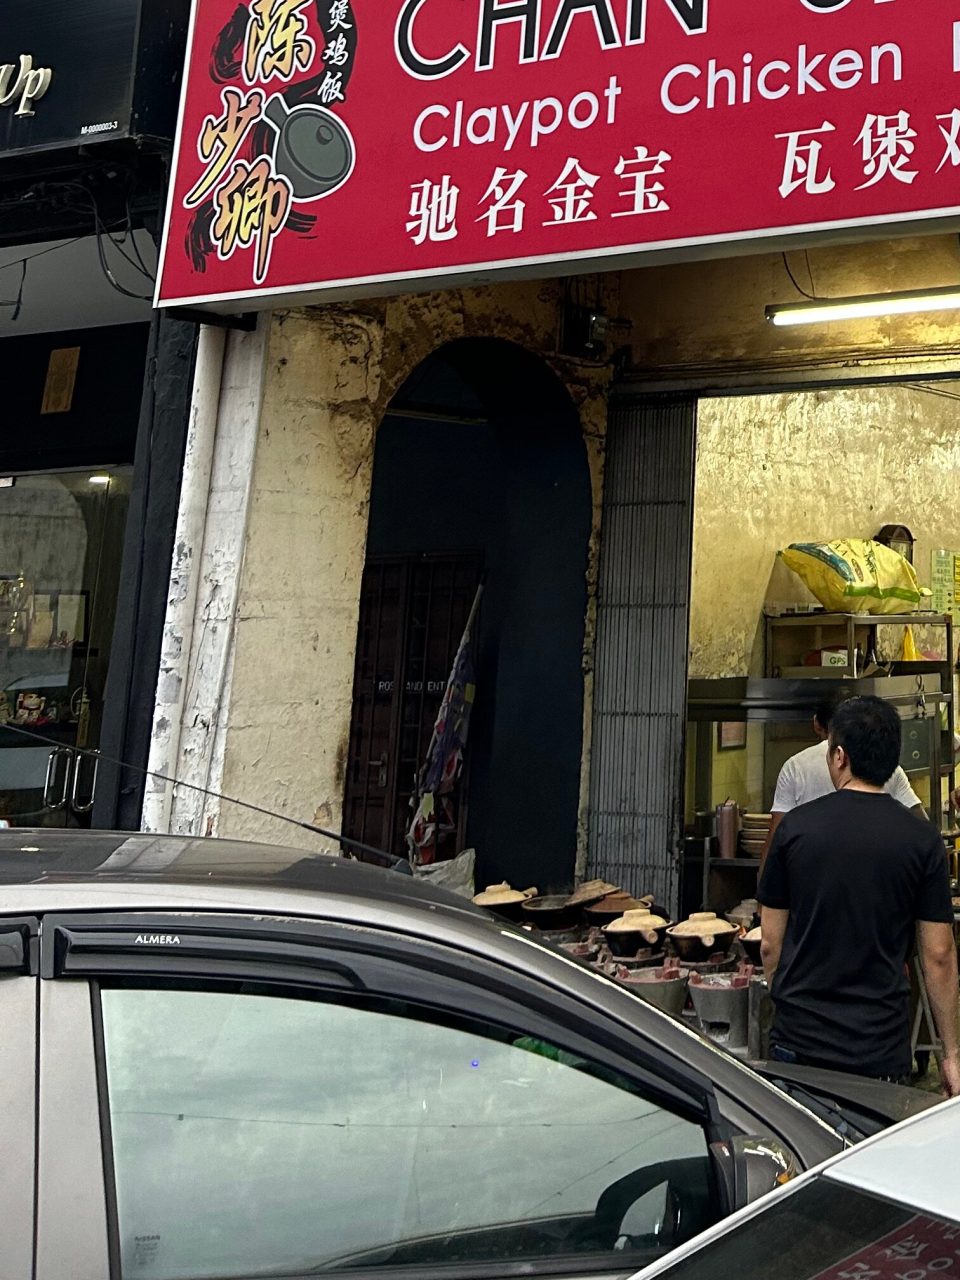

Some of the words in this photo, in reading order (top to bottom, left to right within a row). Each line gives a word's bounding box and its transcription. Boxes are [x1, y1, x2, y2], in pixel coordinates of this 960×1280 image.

[412, 75, 622, 152] Claypot
[660, 42, 902, 115] Chicken
[405, 145, 672, 246] 驰名金宝
[829, 656, 846, 666] GPS
[134, 935, 181, 945] ALMERA
